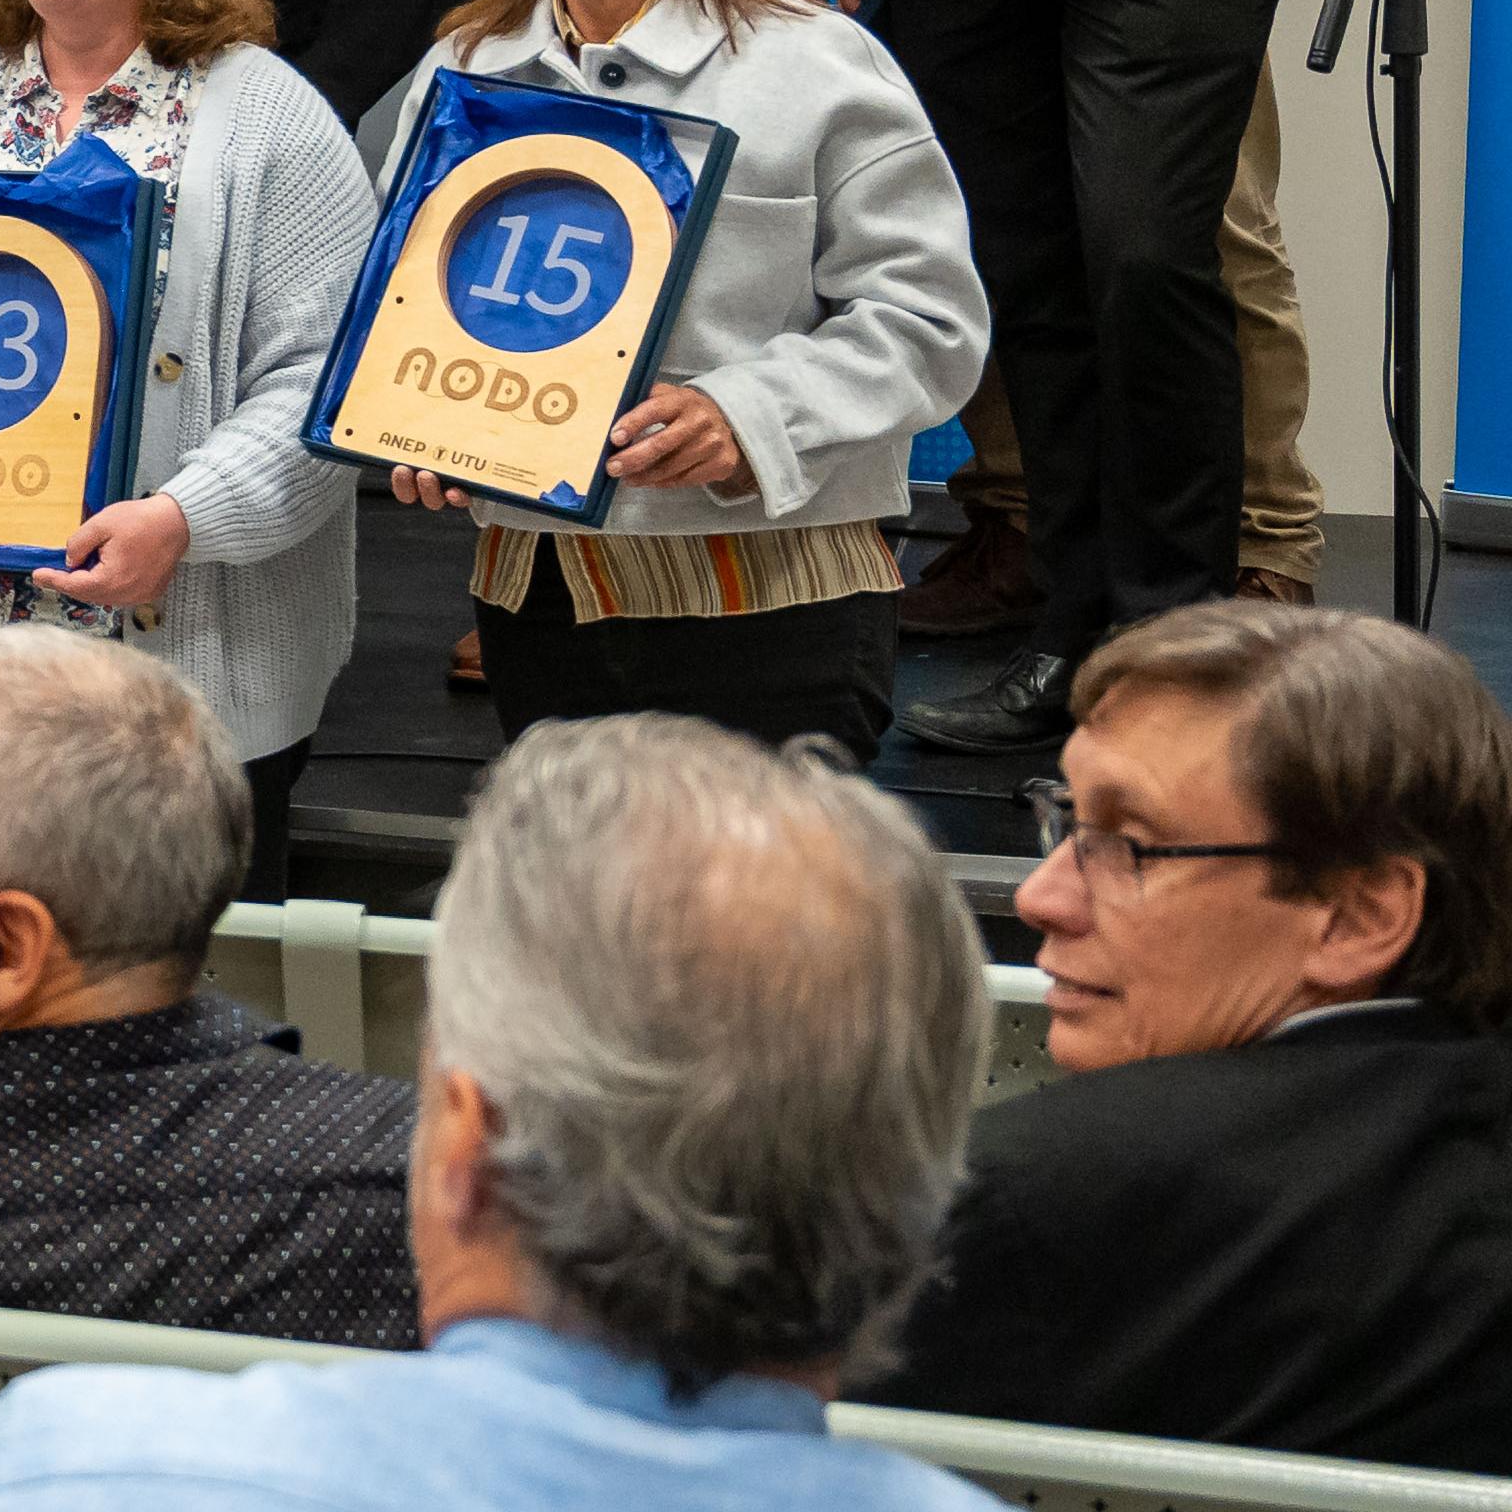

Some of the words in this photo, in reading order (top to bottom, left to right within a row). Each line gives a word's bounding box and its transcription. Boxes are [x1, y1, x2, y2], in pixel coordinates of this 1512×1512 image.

[469, 214, 605, 317] 15
[393, 347, 578, 426] NODO
[378, 432, 426, 454] ANEP
[451, 451, 488, 472] UTU
